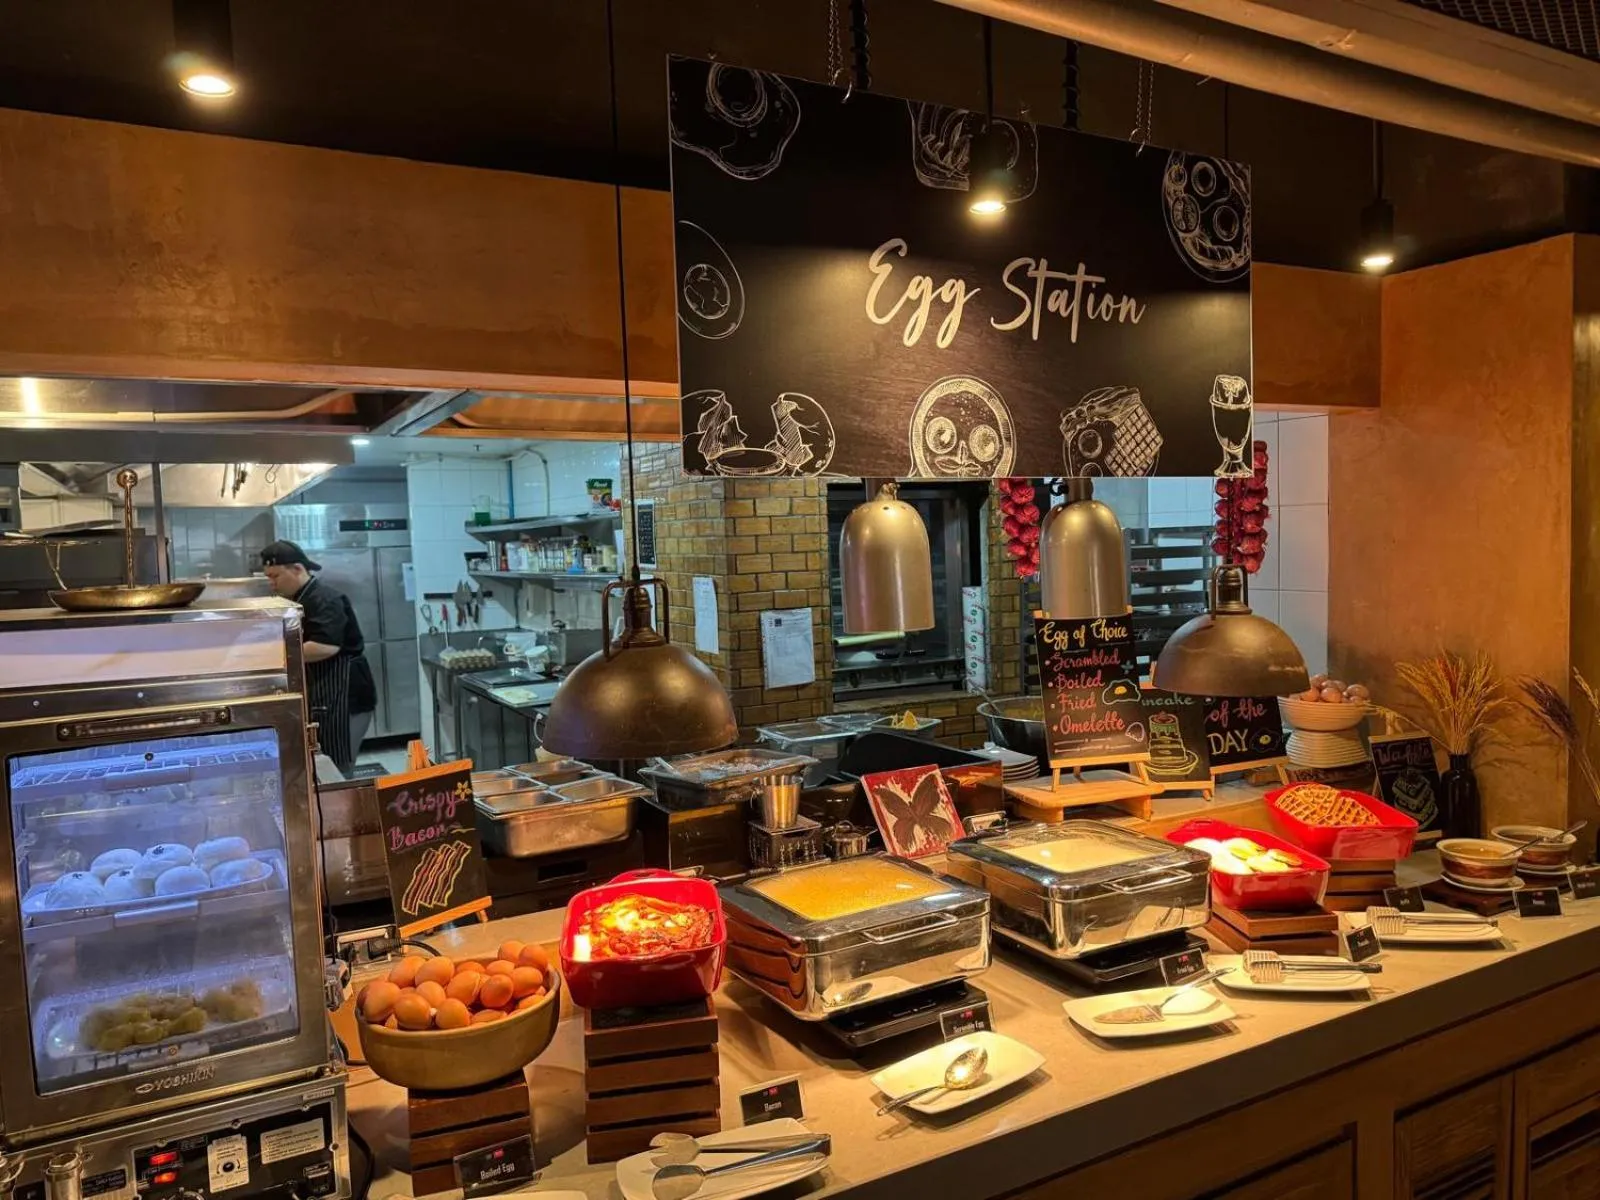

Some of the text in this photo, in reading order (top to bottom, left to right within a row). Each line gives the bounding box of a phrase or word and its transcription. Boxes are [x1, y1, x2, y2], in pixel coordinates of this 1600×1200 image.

[865, 238, 1146, 349] Egg Station
[1039, 618, 1128, 651] Egg of Choice
[1050, 648, 1121, 672] Scrambled
[1054, 670, 1105, 693] Boiled
[1057, 691, 1097, 713] Fried
[1141, 692, 1195, 707] ncake
[1060, 711, 1126, 735] Omelette
[1204, 698, 1268, 728] of the
[1206, 728, 1249, 755] DAY
[386, 787, 464, 821] Crispy
[387, 824, 449, 851] Bacon
[502, 1162, 515, 1173] Egg
